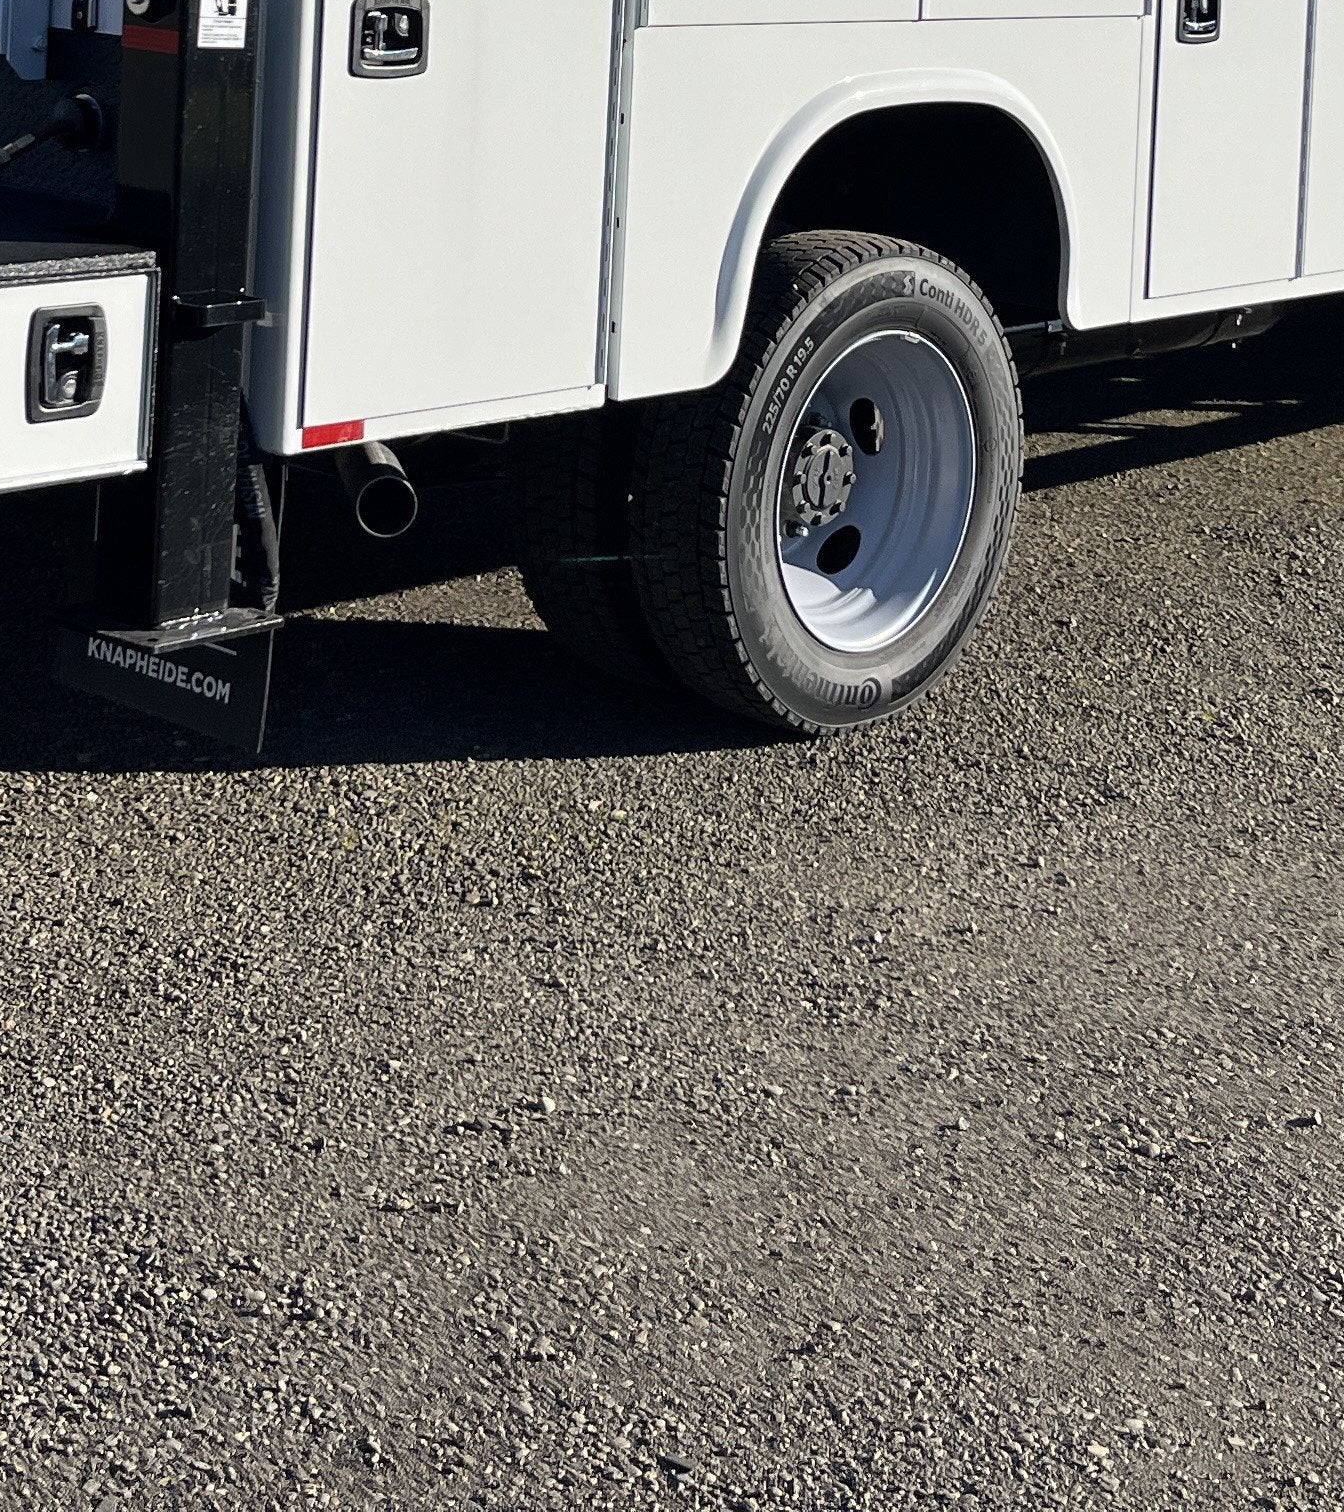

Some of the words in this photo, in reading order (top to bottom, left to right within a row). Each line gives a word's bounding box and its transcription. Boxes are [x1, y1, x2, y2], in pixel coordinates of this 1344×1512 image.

[919, 278, 954, 309] Conti
[762, 377, 791, 435] 225/70
[793, 336, 814, 367] 19.5
[87, 636, 232, 705] KNAPHEIDE.COM
